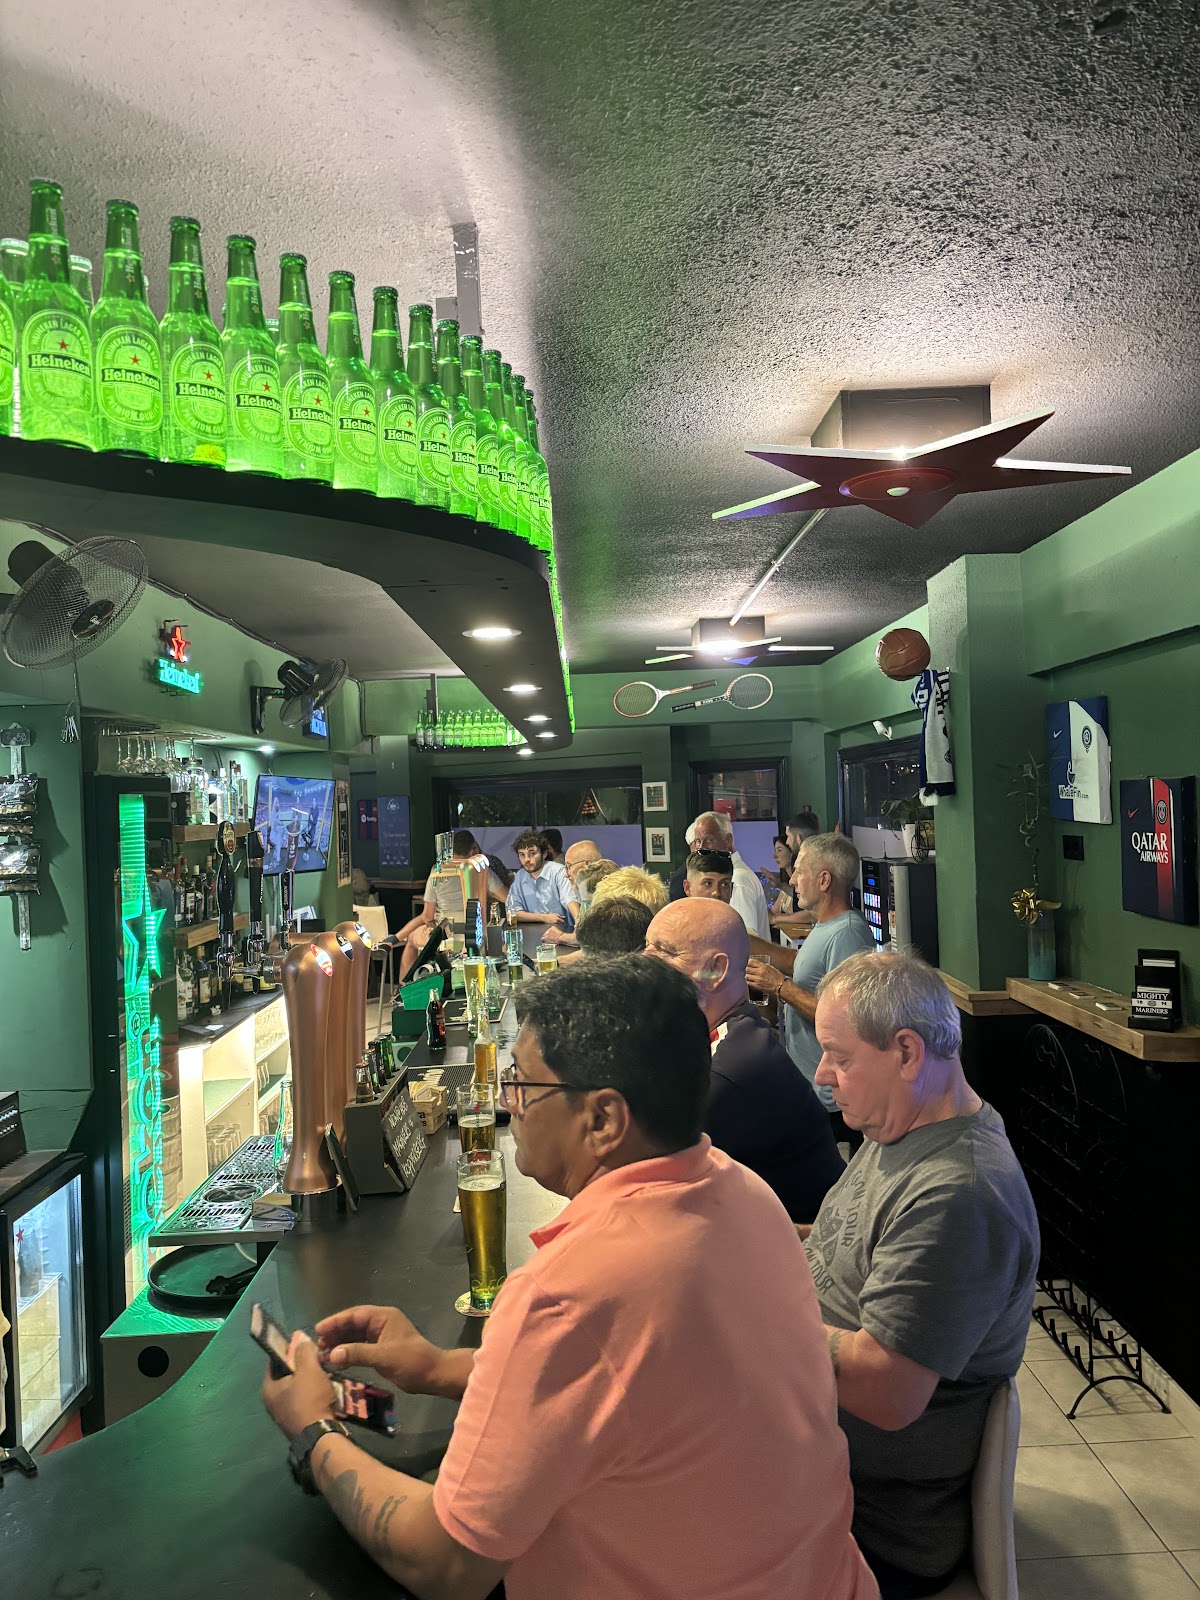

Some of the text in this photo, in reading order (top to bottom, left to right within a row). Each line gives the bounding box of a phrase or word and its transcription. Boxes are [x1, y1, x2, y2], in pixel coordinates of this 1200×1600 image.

[48, 207, 60, 254] Heneken
[125, 228, 134, 272] Heeken
[191, 243, 202, 289] Heiken
[300, 279, 310, 320] Heeken
[132, 334, 152, 350] LAGER
[31, 354, 91, 378] Heineken
[104, 368, 160, 389] Heineken
[179, 383, 226, 401] Heineke
[239, 395, 281, 410] Heineke
[293, 408, 332, 421] Heineke
[343, 419, 375, 432] Heinek
[388, 430, 416, 441] Heine
[423, 441, 449, 455] Heine
[455, 453, 477, 465] Hein
[159, 659, 200, 694] Heineken
[1131, 832, 1168, 853] QATAR
[1140, 850, 1169, 864] AIRWAYS
[1136, 992, 1169, 1000] MIGHTY
[840, 1201, 863, 1247] TOUR
[810, 1259, 835, 1295] TOUR
